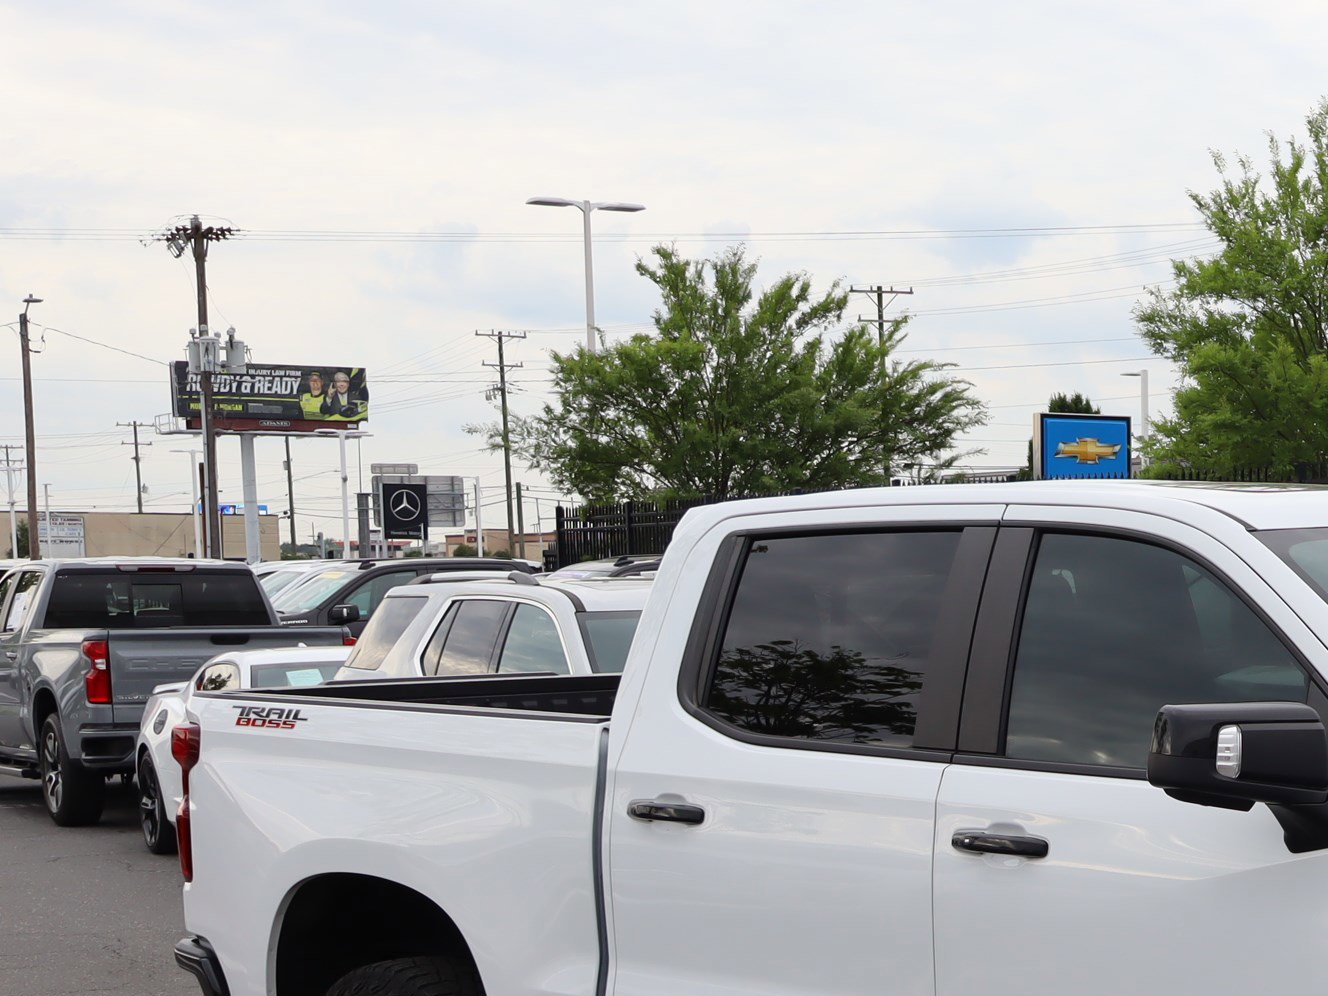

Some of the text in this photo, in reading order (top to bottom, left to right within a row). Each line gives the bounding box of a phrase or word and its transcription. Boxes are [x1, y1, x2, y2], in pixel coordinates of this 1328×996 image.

[254, 375, 302, 395] READY
[232, 705, 309, 721] TRAIL
[235, 717, 297, 730] BOSS
